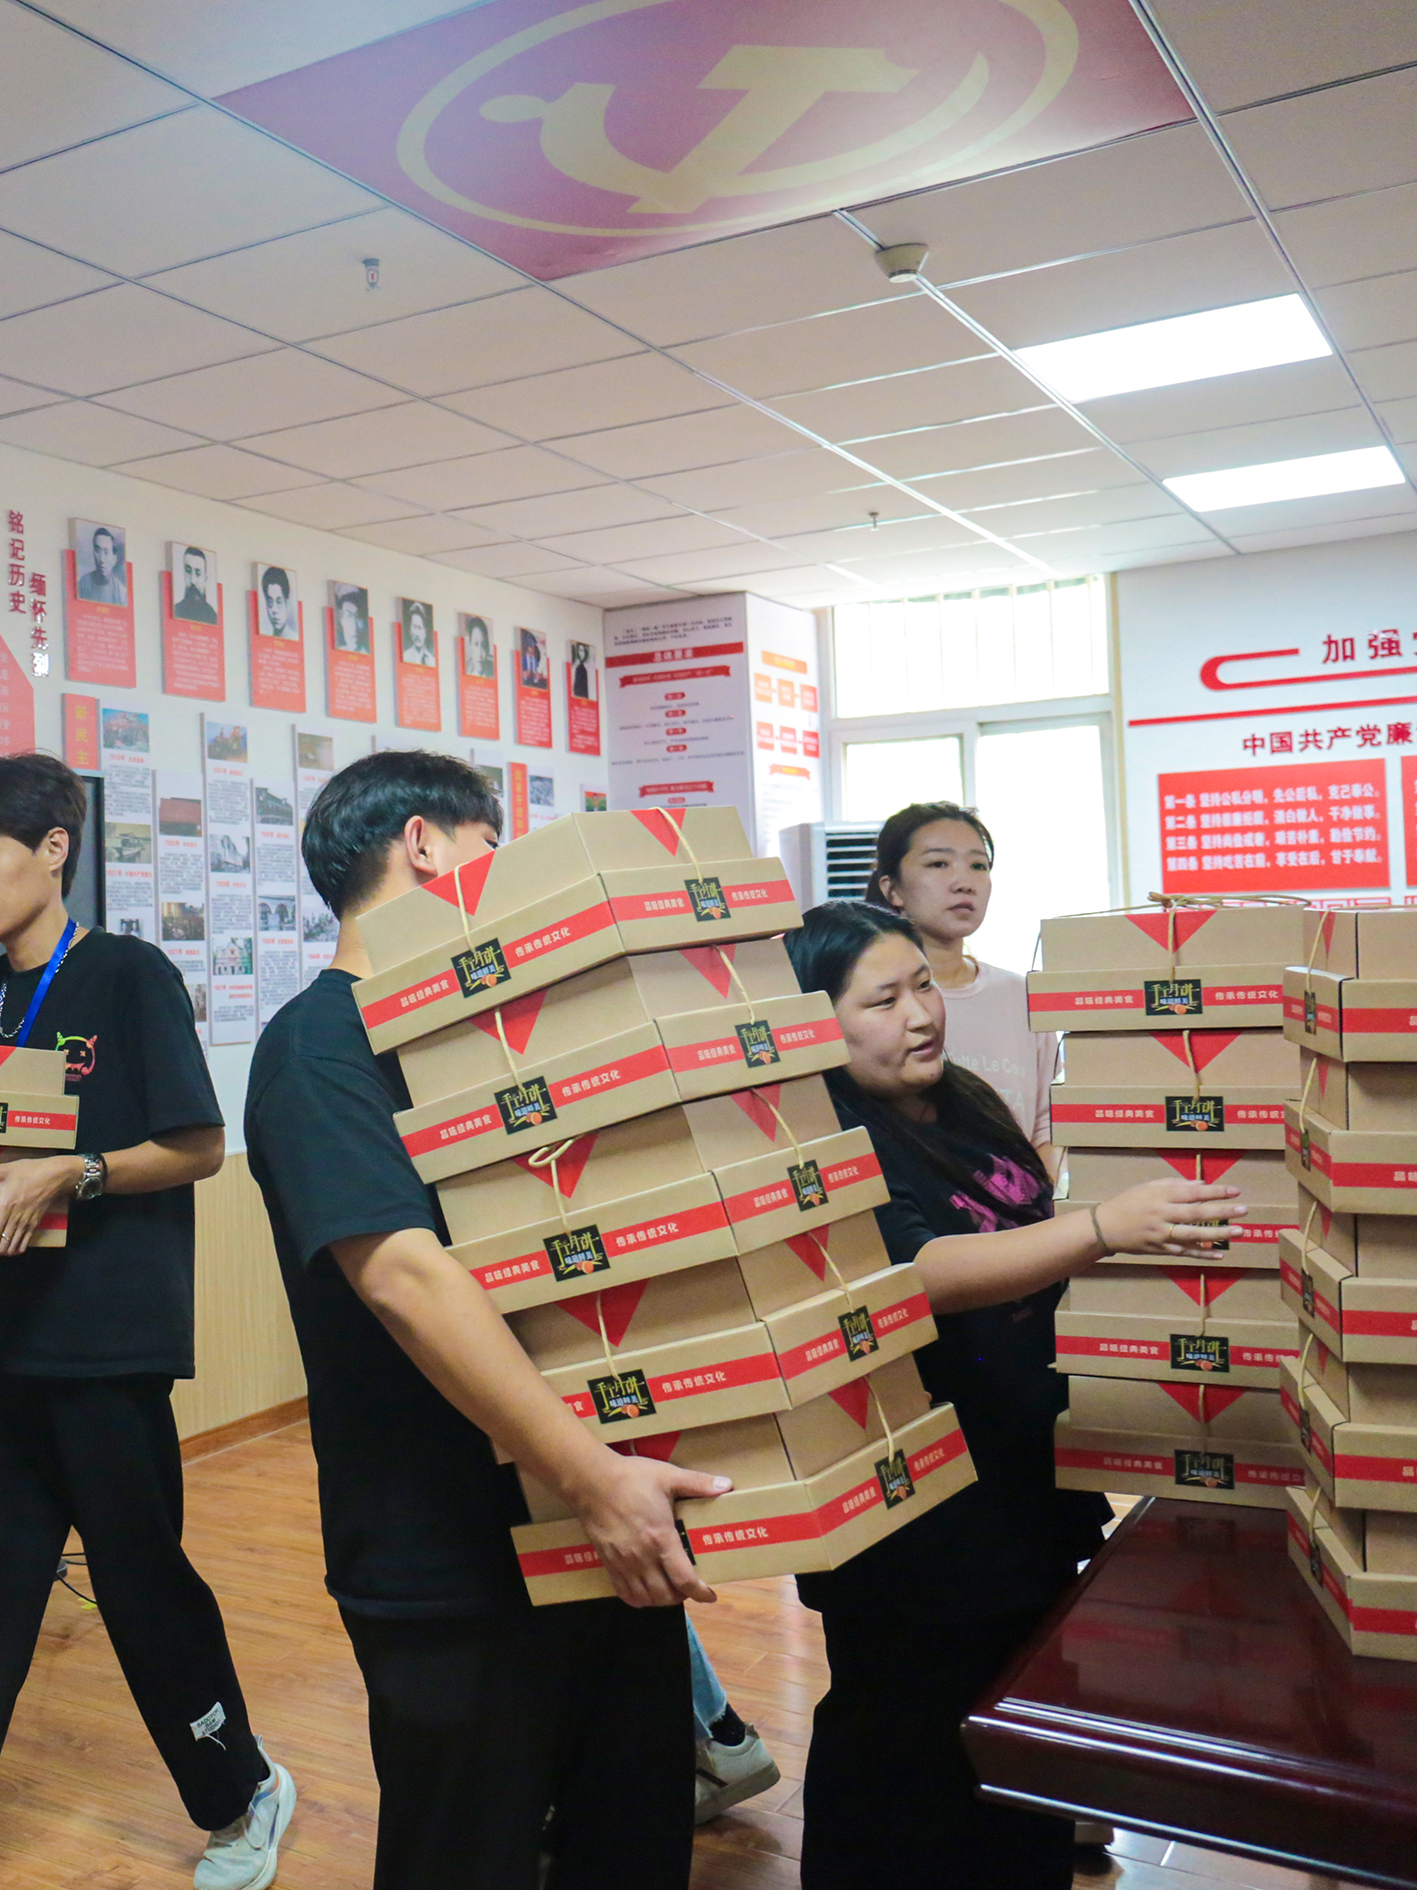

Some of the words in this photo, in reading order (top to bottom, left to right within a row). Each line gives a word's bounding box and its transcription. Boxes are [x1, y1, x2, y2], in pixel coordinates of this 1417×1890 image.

[7, 509, 26, 614] 铭记历史
[29, 572, 50, 677] 缅怀先烈
[1322, 628, 1417, 664] 加强
[1243, 721, 1417, 756] 中国共产党廉
[515, 926, 571, 958] 传承传统文化
[400, 979, 449, 1008] 品味经典美食
[1075, 995, 1134, 1006] 品味经典美食
[1215, 989, 1278, 1001] 传承传统文化
[561, 1069, 621, 1098] 传承传统文化
[439, 1114, 493, 1140] 品味经典美食
[1095, 1109, 1154, 1119] 品味经典美食
[616, 1222, 679, 1248] 传承传统文化
[484, 1259, 541, 1283] 品味经典美食
[1099, 1342, 1159, 1355] 品味经典美食
[662, 1371, 727, 1394] 传承传统文化
[702, 1526, 768, 1545] 传承传统文化
